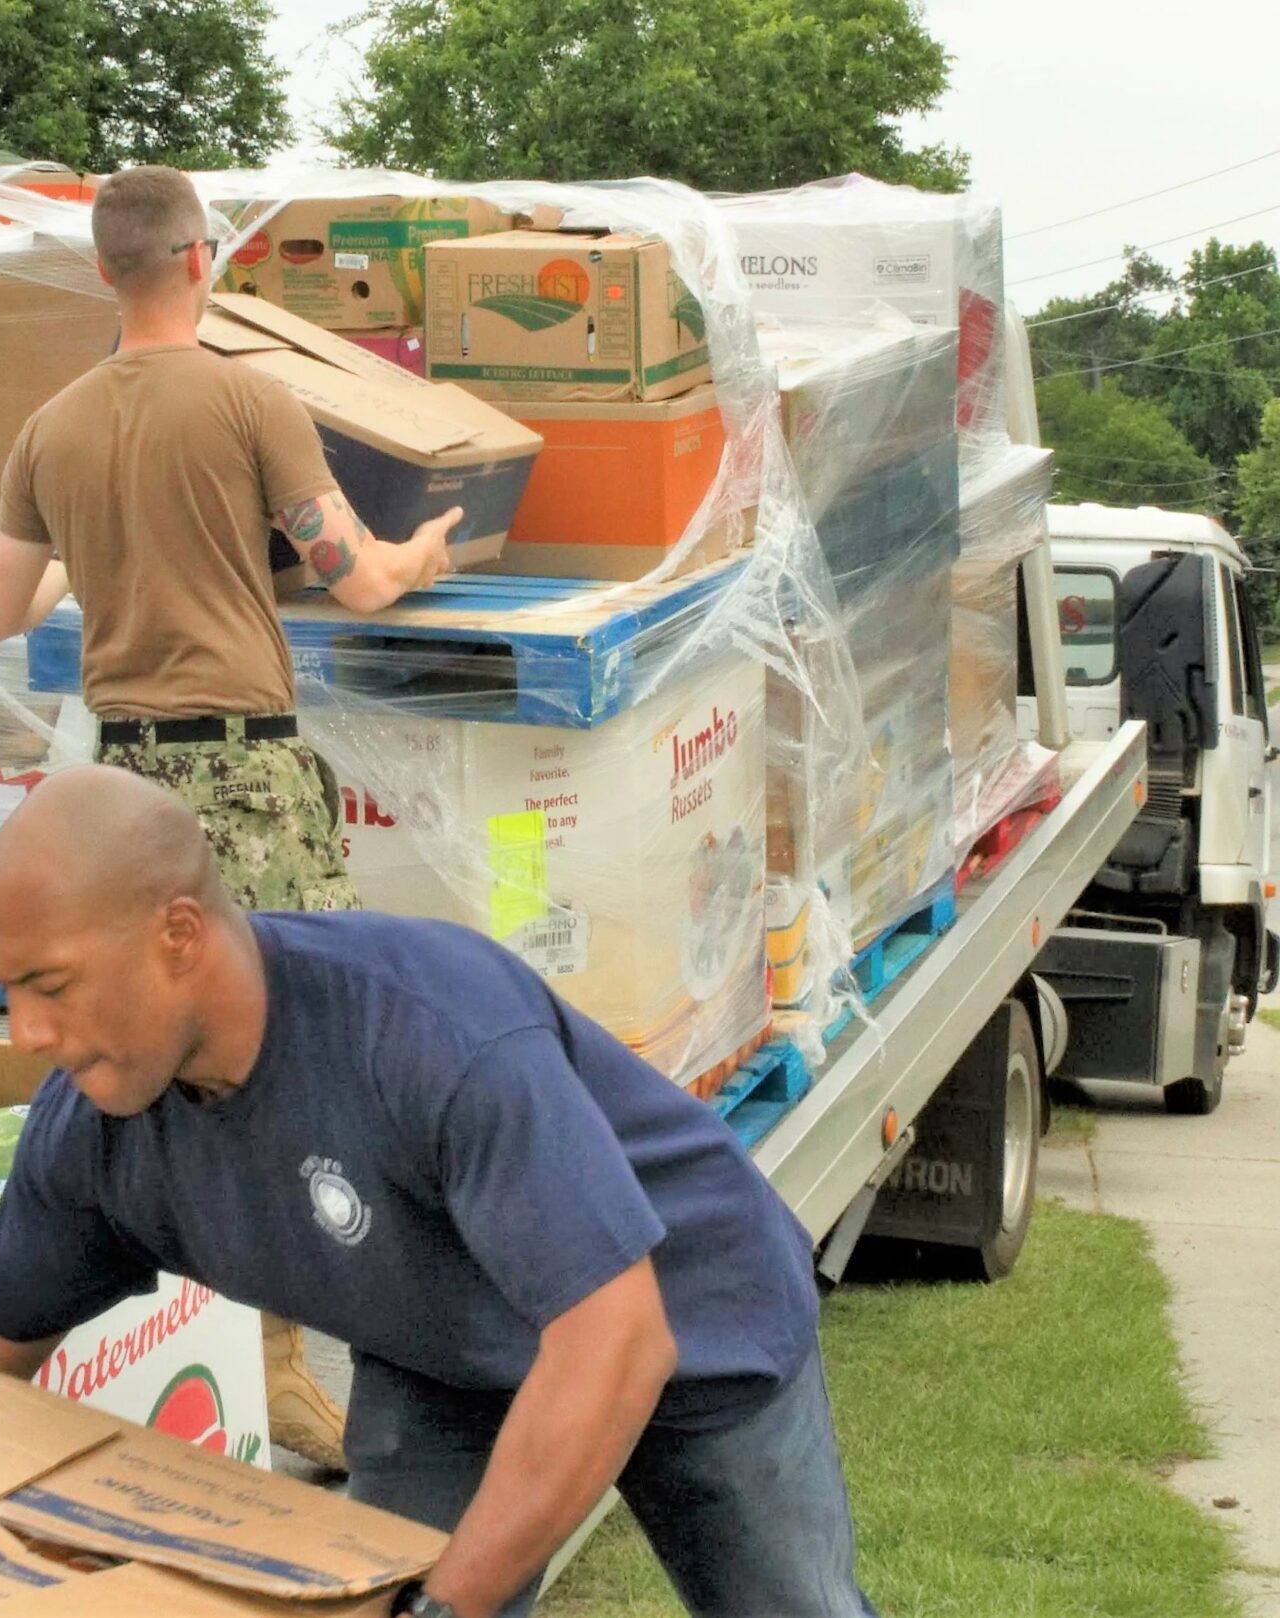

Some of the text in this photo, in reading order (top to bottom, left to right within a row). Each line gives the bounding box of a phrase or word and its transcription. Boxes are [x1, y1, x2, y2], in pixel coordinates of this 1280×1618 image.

[332, 233, 390, 247] Premium
[756, 278, 800, 290] seedless
[534, 745, 565, 761] Family
[670, 706, 738, 790] Jumbo
[530, 767, 570, 783] Favorite.
[524, 793, 578, 812] The perfect
[671, 777, 713, 825] Russets
[548, 814, 577, 830] to any
